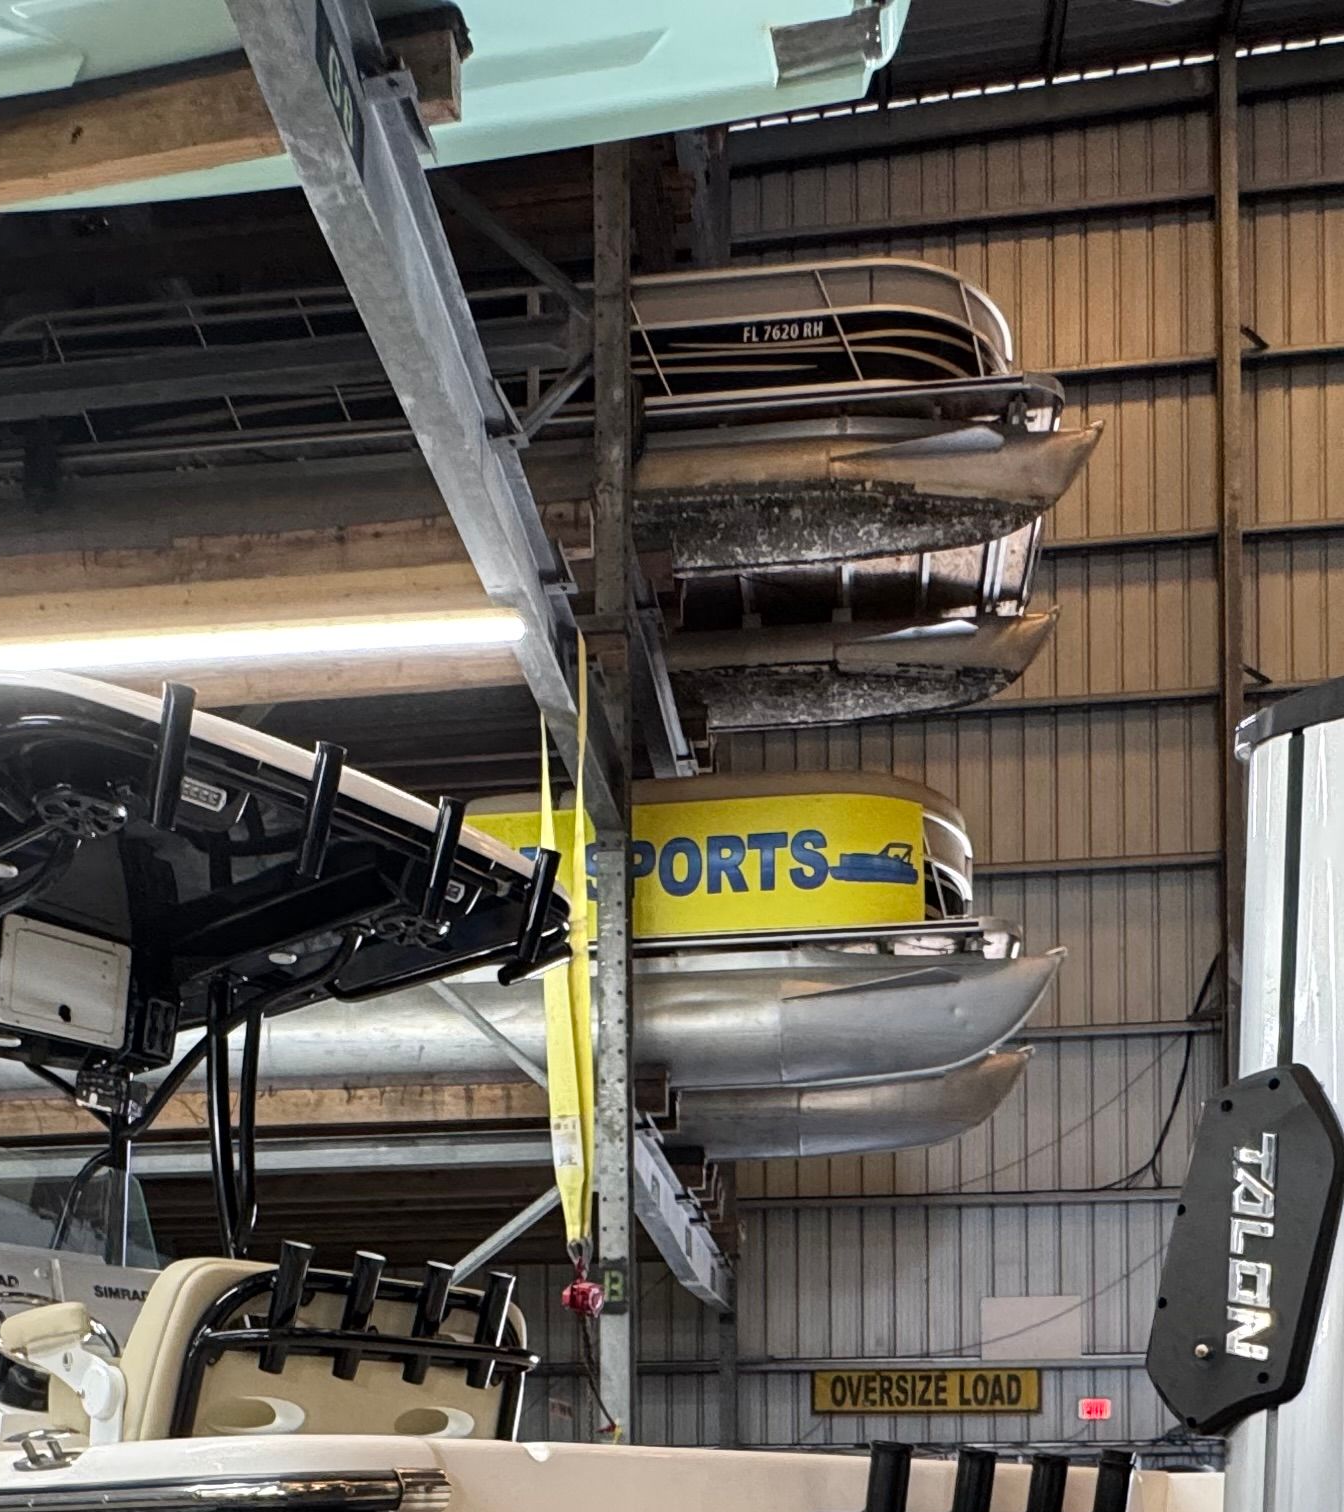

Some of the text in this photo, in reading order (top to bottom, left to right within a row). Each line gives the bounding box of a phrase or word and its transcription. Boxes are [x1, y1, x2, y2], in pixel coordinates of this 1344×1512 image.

[743, 320, 824, 342] FL 7620 RH
[586, 830, 829, 899] PORTS
[1225, 1132, 1278, 1362] TALON
[604, 1269, 625, 1302] B
[830, 1374, 1022, 1407] OVERSIZE LOAD
